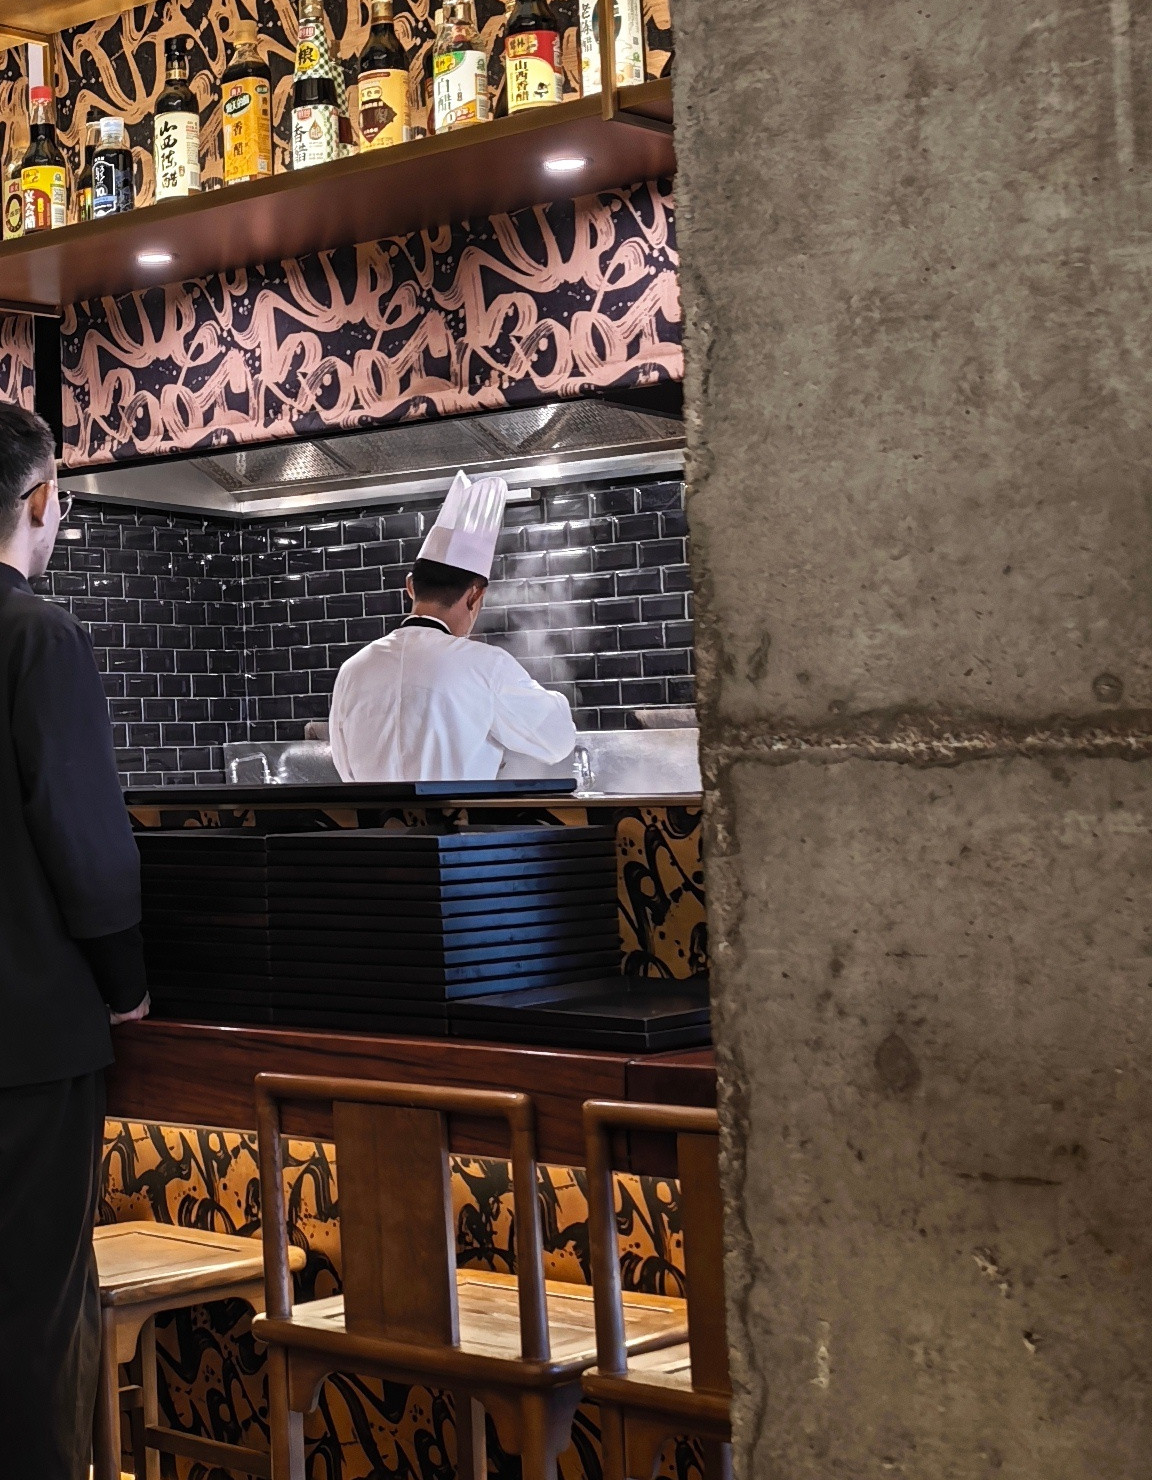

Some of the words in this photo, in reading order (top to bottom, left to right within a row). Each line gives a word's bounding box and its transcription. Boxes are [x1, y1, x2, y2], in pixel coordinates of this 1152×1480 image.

[514, 60, 529, 103] 山西香醋
[159, 120, 178, 189] 山西陈醋
[232, 120, 244, 157] 香醋
[293, 122, 309, 163] 香醋
